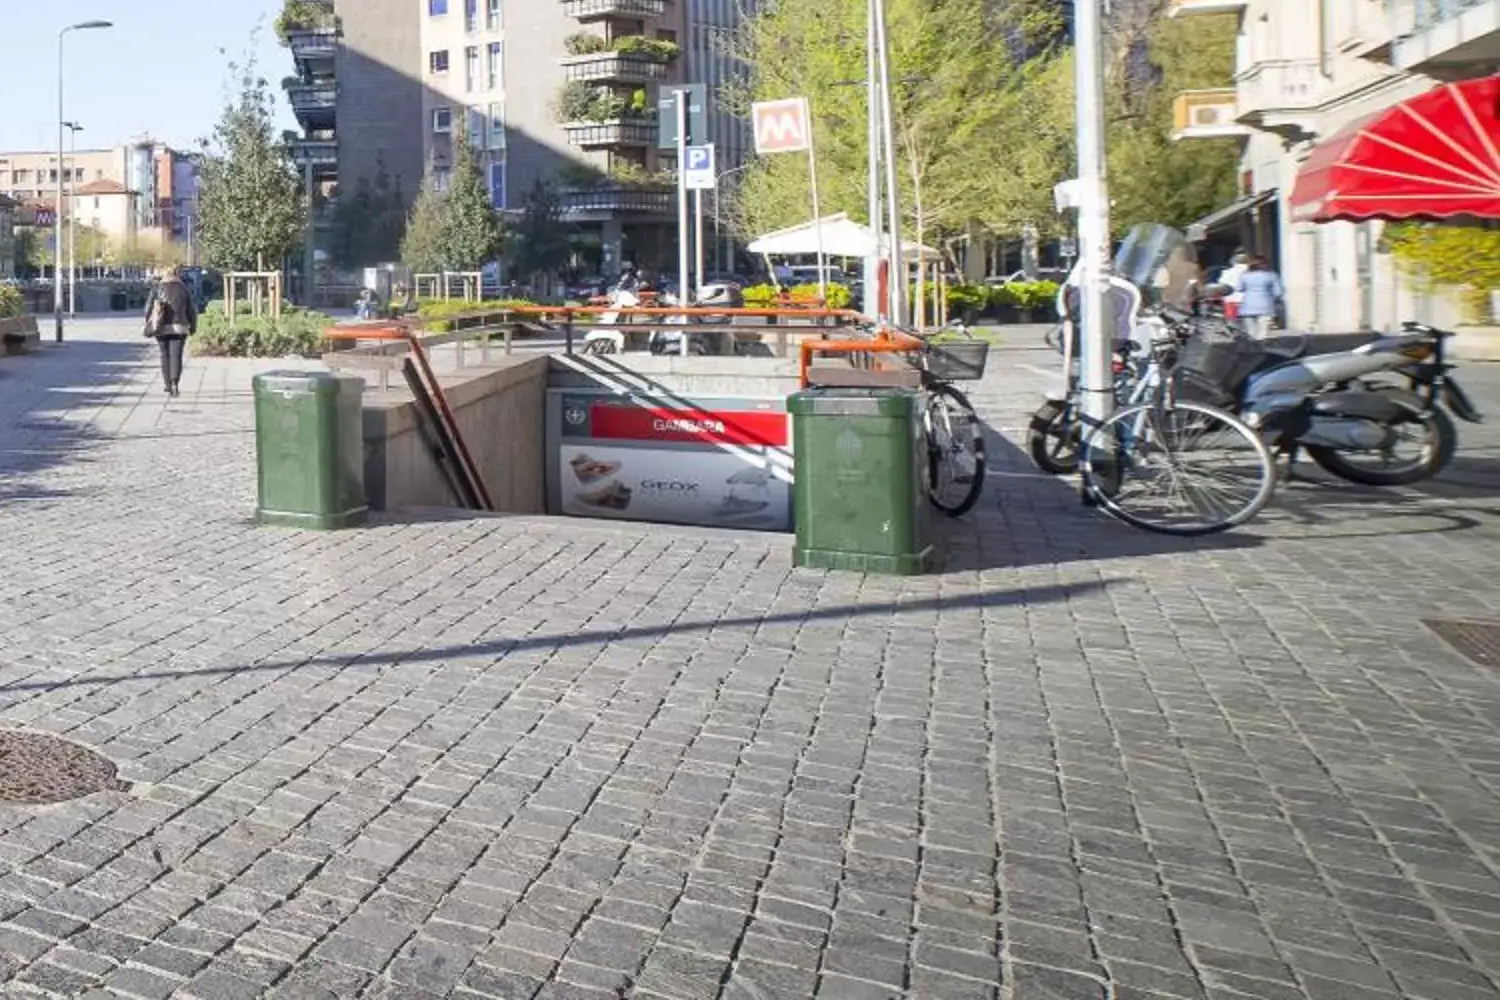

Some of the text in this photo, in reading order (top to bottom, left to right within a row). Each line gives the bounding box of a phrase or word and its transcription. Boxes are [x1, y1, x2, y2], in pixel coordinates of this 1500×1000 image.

[761, 112, 803, 141] M
[689, 150, 707, 168] P
[640, 479, 699, 491] GEOX
